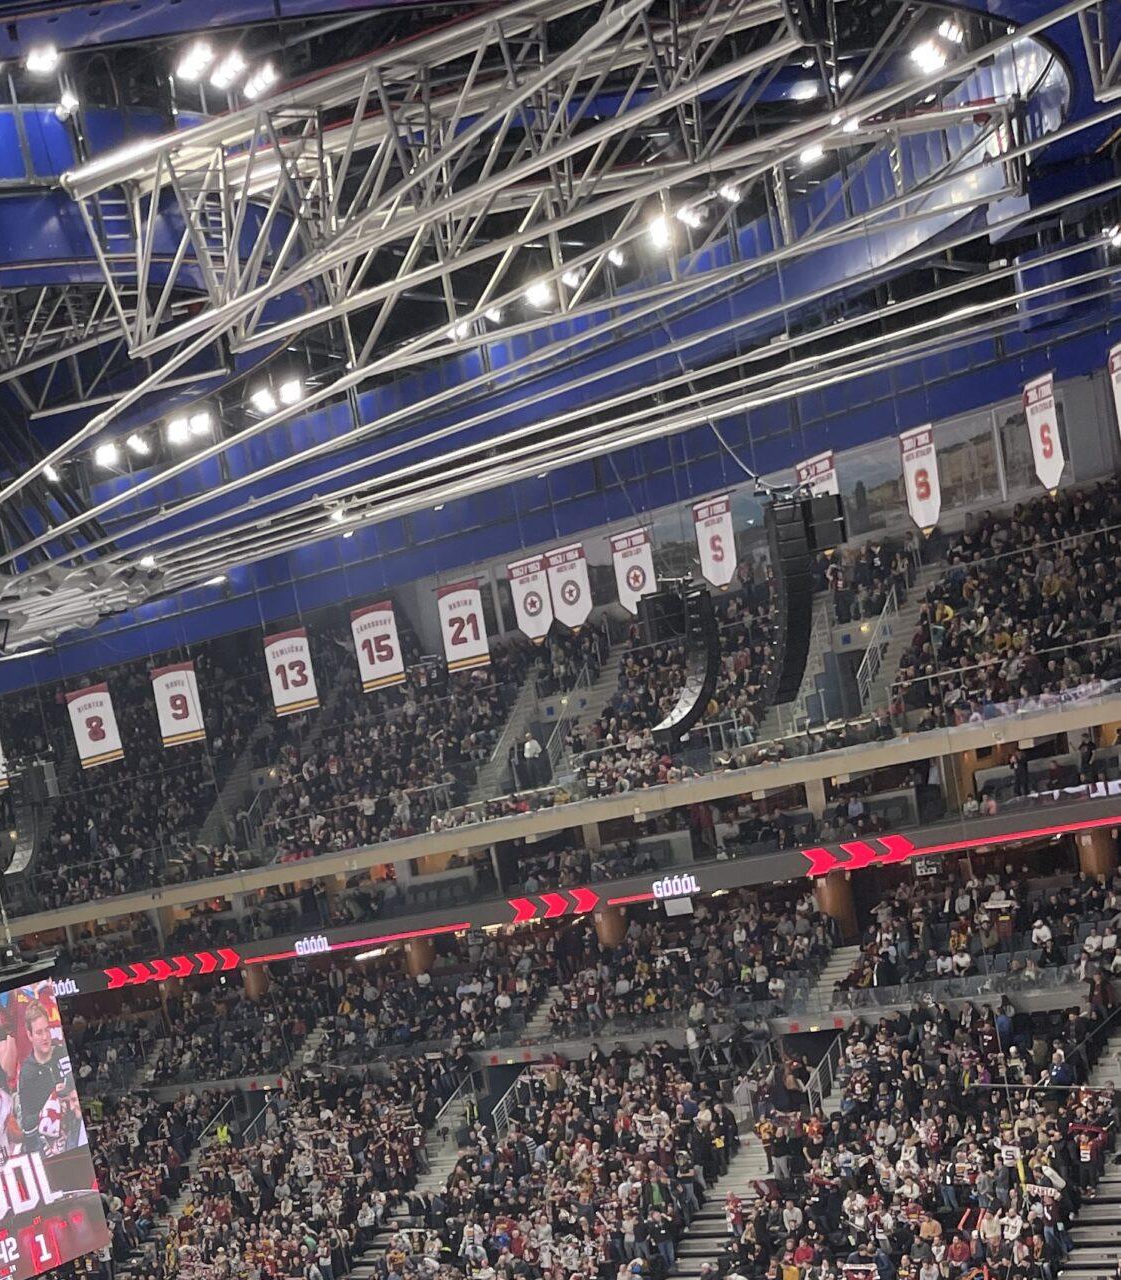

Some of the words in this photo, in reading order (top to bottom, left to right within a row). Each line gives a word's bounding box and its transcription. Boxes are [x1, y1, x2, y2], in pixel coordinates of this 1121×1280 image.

[1040, 423, 1053, 460] S
[914, 468, 931, 502] S
[709, 534, 724, 562] S
[448, 612, 480, 646] 21
[361, 633, 394, 665] 15
[275, 660, 308, 690] 13
[169, 693, 190, 720] 9
[85, 715, 106, 742] 8
[652, 875, 701, 899] GÓÓÓL
[295, 934, 331, 956] GÓÓÓL
[52, 978, 80, 997] ÓÓÓL
[34, 1233, 52, 1262] 1
